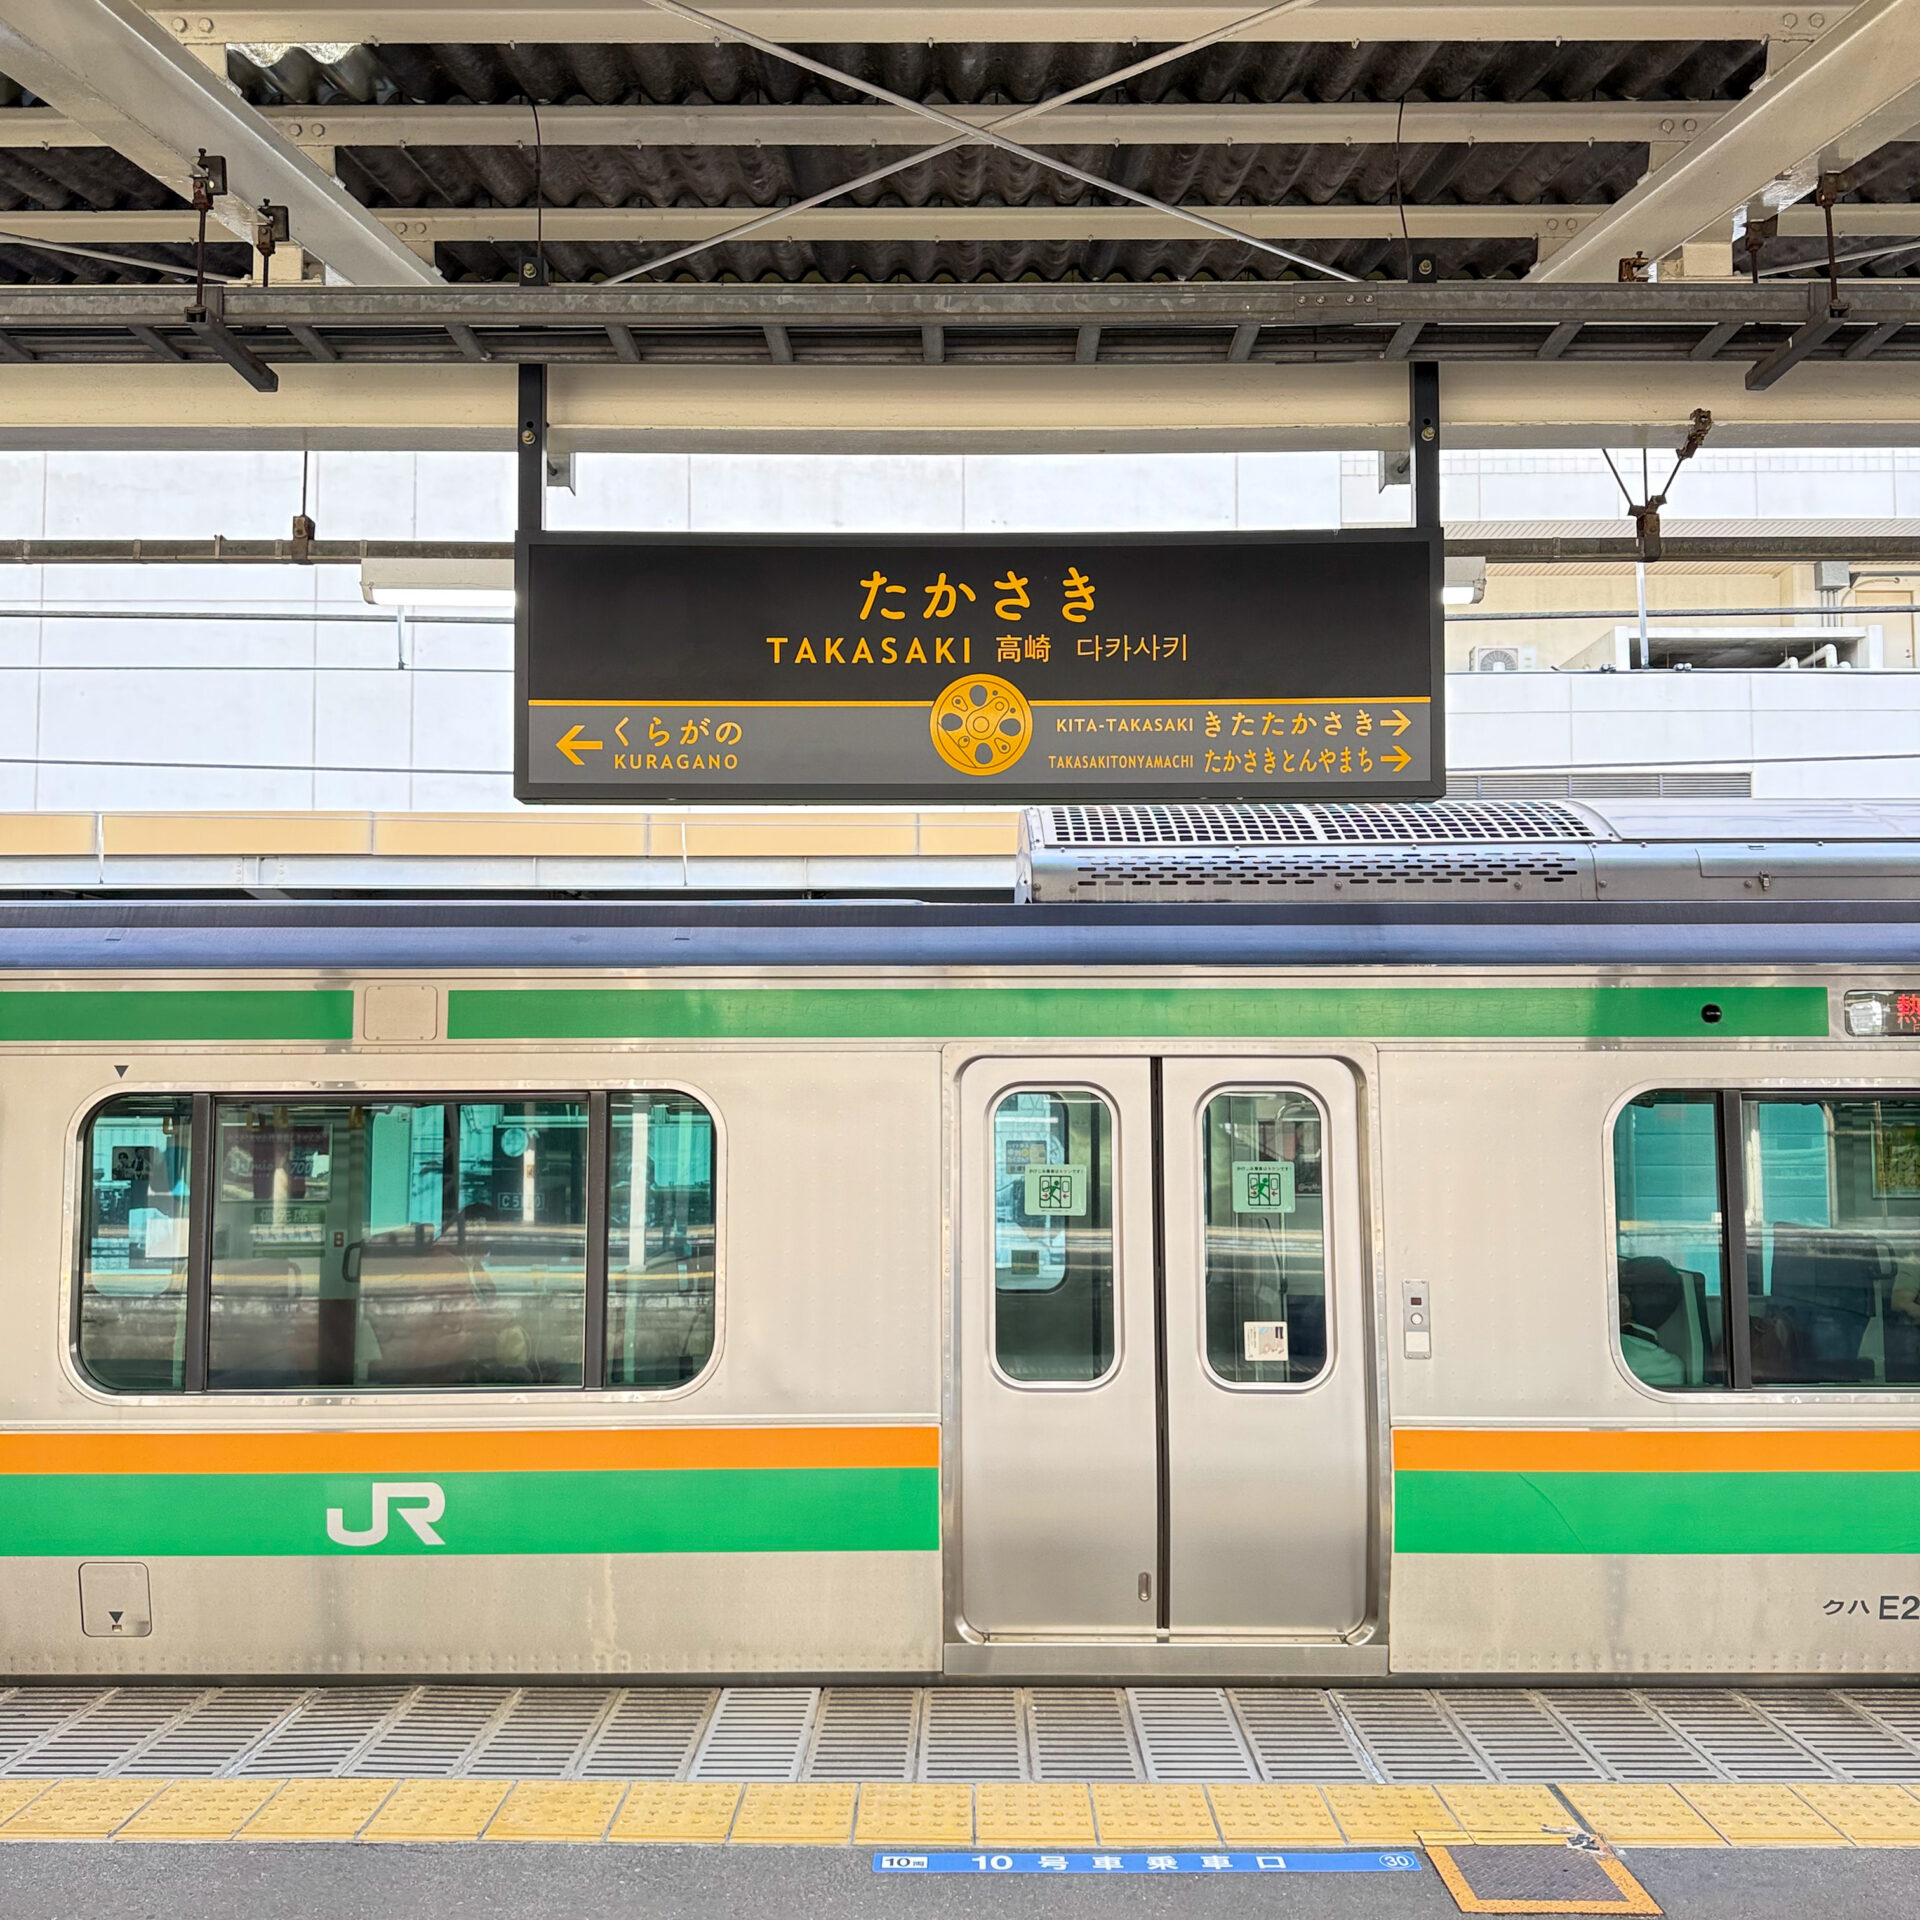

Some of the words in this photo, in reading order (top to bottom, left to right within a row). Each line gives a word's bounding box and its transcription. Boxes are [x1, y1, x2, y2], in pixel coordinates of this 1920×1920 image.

[859, 567, 1096, 624] たかさき
[766, 636, 971, 665] TAKASAKI
[996, 633, 1051, 663] 高崎
[1076, 633, 1188, 662] 다카사키
[614, 716, 743, 748] くらがの
[1056, 718, 1194, 732] KITA-TAKASAKI
[1204, 709, 1373, 738] きたたかさき
[614, 753, 739, 770] KURAGANO
[1048, 754, 1194, 769] TAKASAKITONYAMACHI
[1204, 746, 1374, 774] たかさきとんやまち
[326, 1482, 446, 1547] JR
[1822, 1599, 1870, 1616] クハ
[1879, 1595, 1920, 1620] E2
